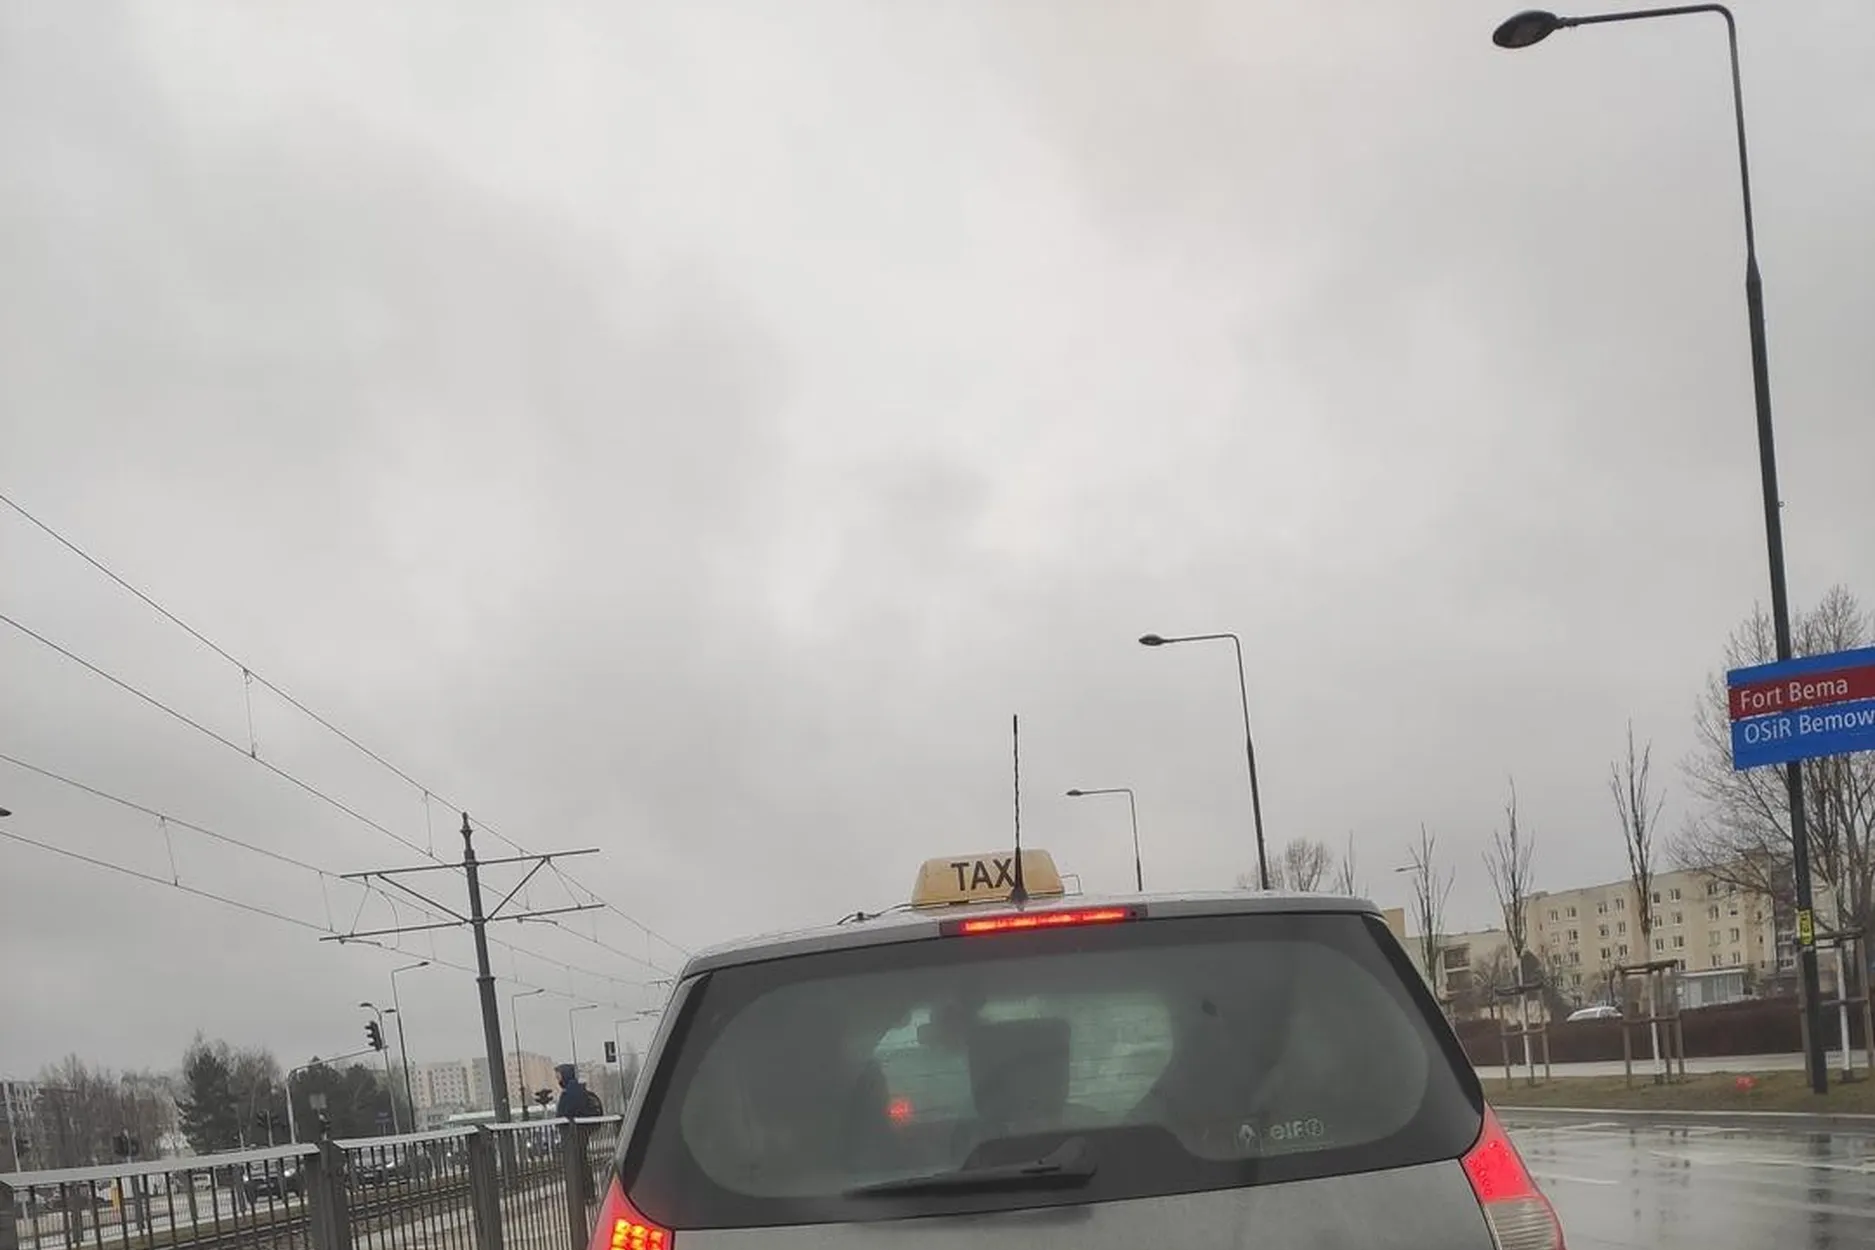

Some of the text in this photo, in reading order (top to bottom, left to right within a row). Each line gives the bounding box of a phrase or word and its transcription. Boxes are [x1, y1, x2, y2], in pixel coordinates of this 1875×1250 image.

[1740, 678, 1848, 711] Fort Bema
[1744, 717, 1792, 744] OSiR
